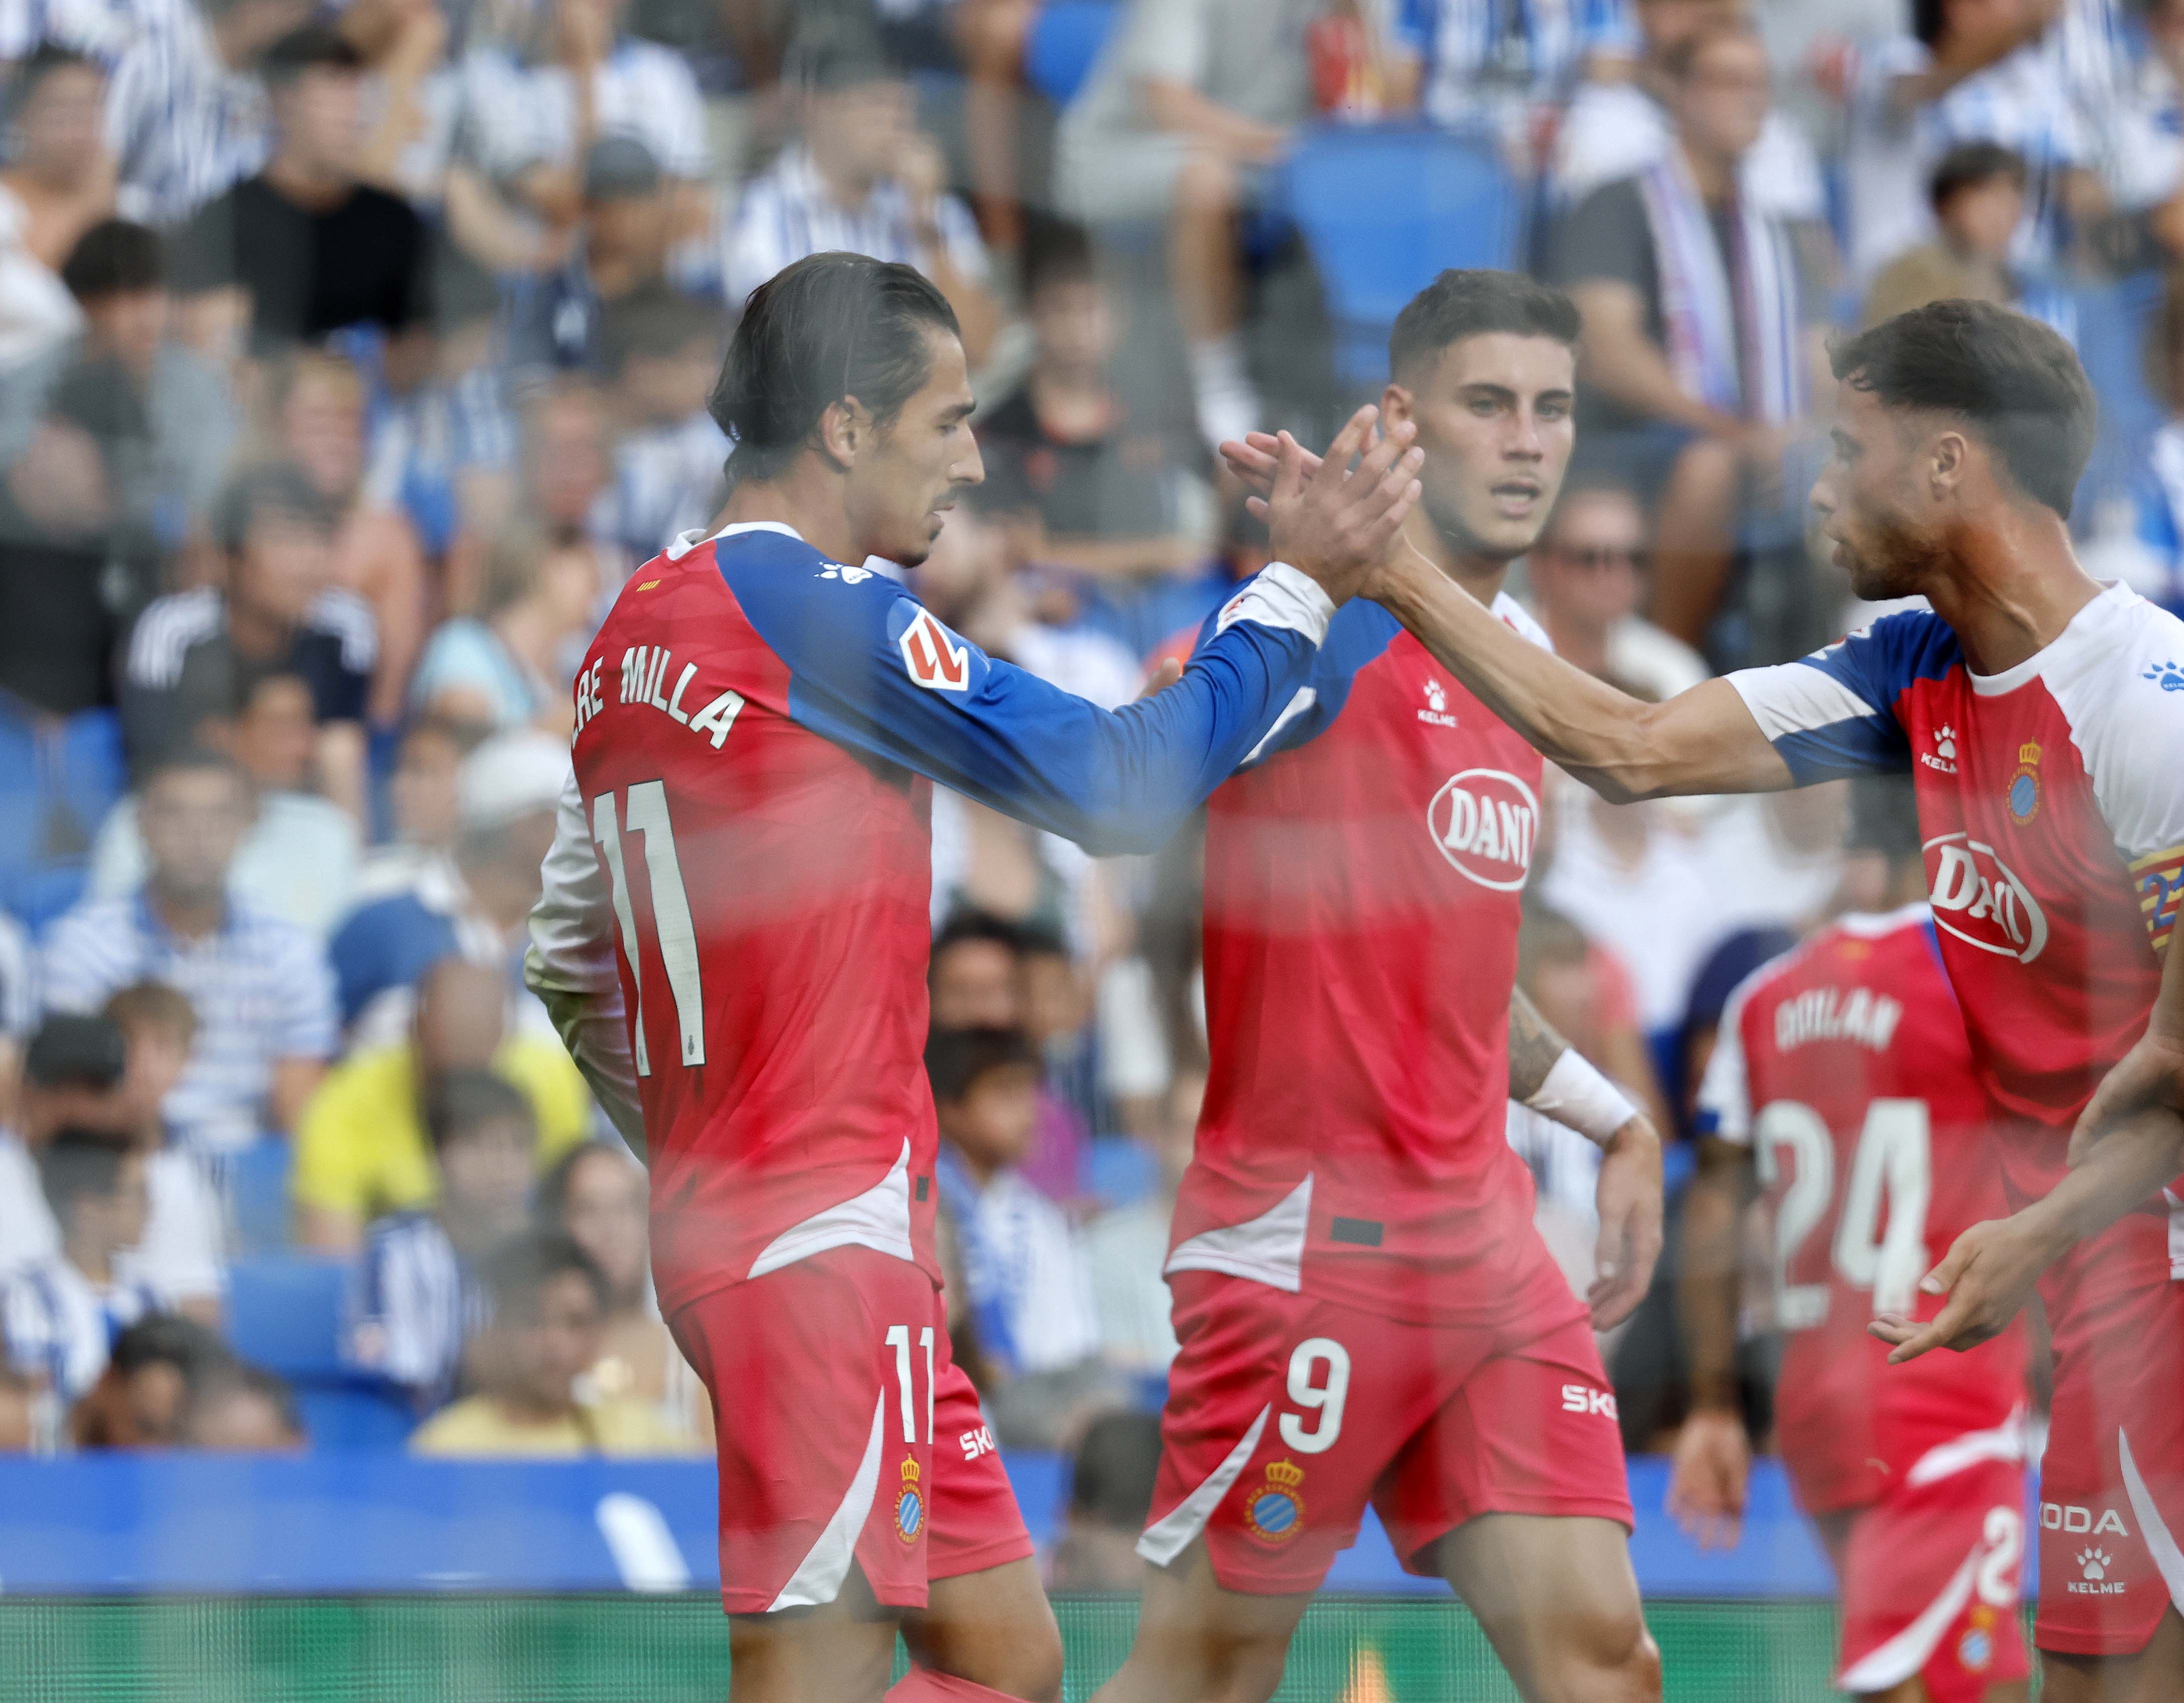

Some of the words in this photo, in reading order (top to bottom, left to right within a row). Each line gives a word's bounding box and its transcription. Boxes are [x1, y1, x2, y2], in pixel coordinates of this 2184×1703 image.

[572, 656, 604, 749] RE
[619, 645, 746, 749] MILLA
[1417, 709, 1458, 727] KELME
[1444, 787, 1531, 870] DANI
[593, 778, 706, 1078] 11
[1754, 1098, 1931, 1331] 24
[885, 1324, 934, 1445] 11
[1279, 1337, 1351, 1454] 9
[959, 1425, 995, 1461] SK
[2038, 1501, 2129, 1536] ODA
[2067, 1581, 2125, 1594] KELME
